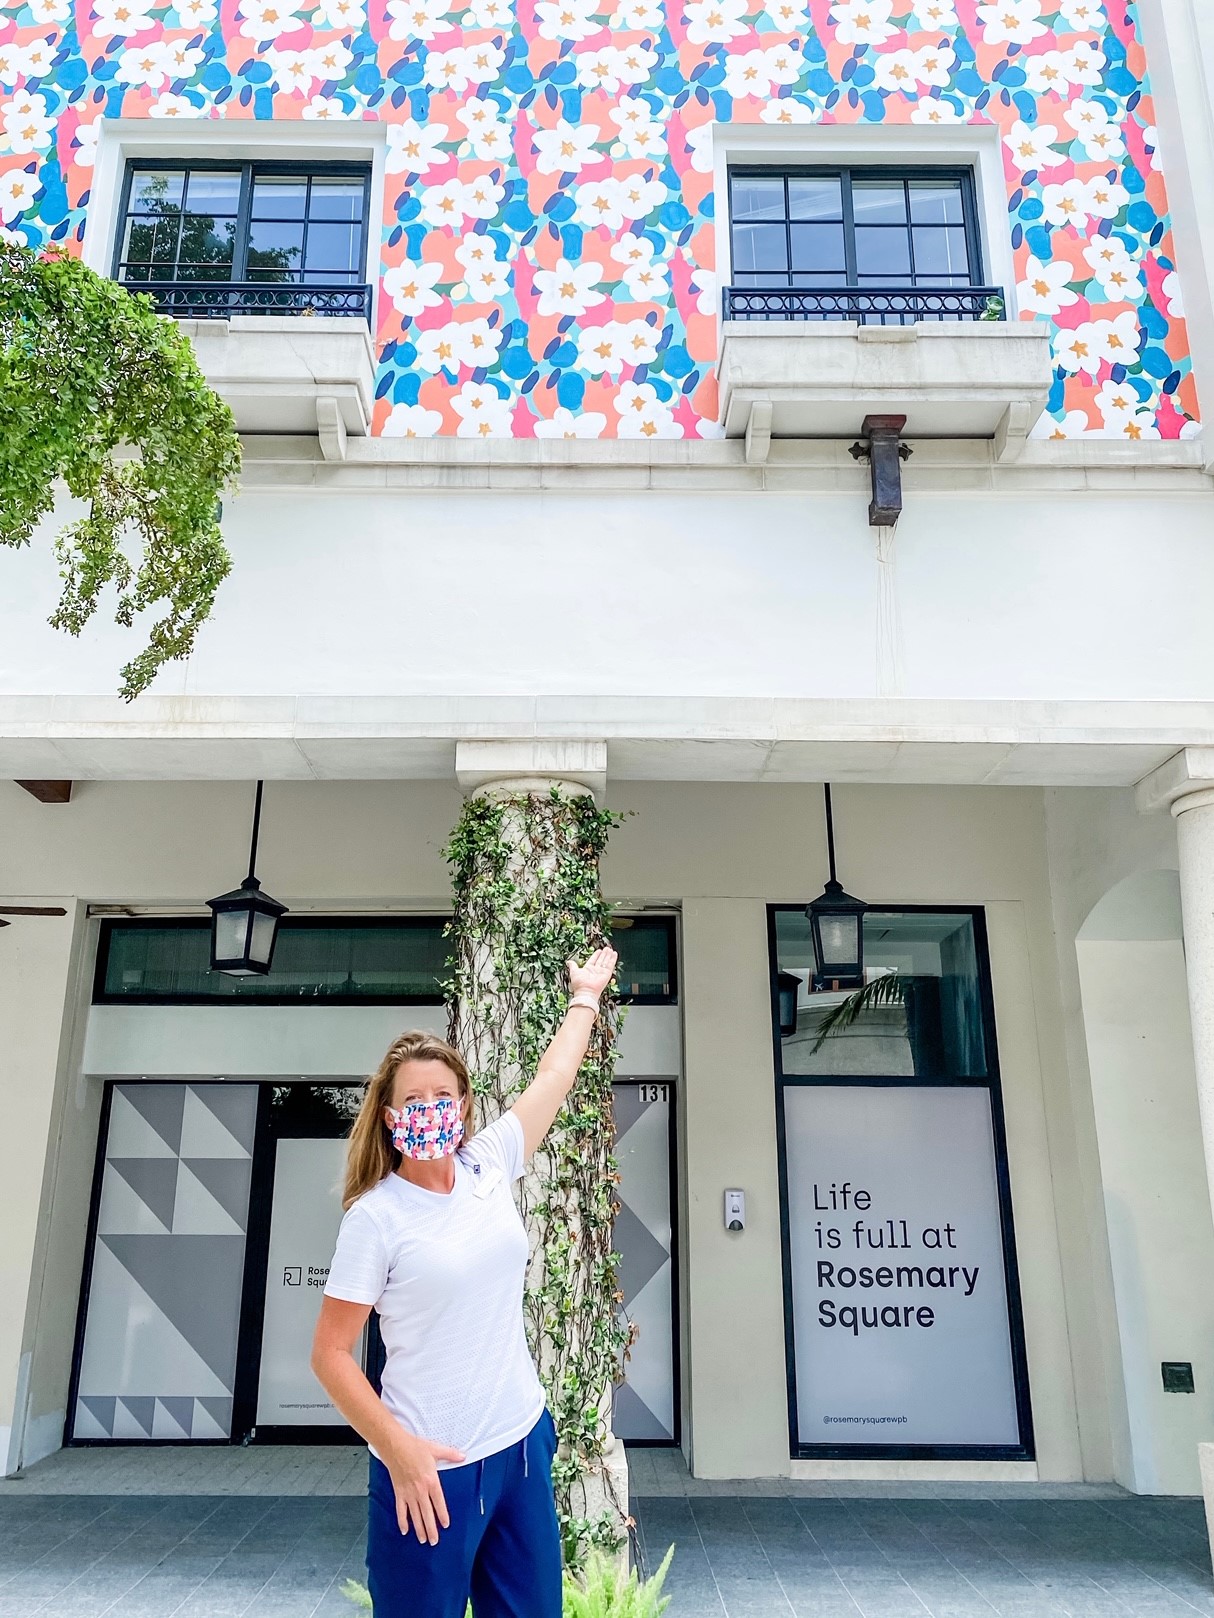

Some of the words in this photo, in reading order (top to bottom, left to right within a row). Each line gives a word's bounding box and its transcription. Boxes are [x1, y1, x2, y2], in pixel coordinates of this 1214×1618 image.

[640, 1085, 667, 1102] 131
[813, 1183, 872, 1210] Life
[814, 1221, 842, 1249] is
[852, 1220, 912, 1249] full
[922, 1223, 957, 1249] at
[308, 1266, 330, 1275] Rose
[816, 1260, 980, 1297] Rosemary
[307, 1277, 327, 1288] Squ
[818, 1300, 935, 1336] Square
[823, 1415, 908, 1425] @rosemarysquarewpb
